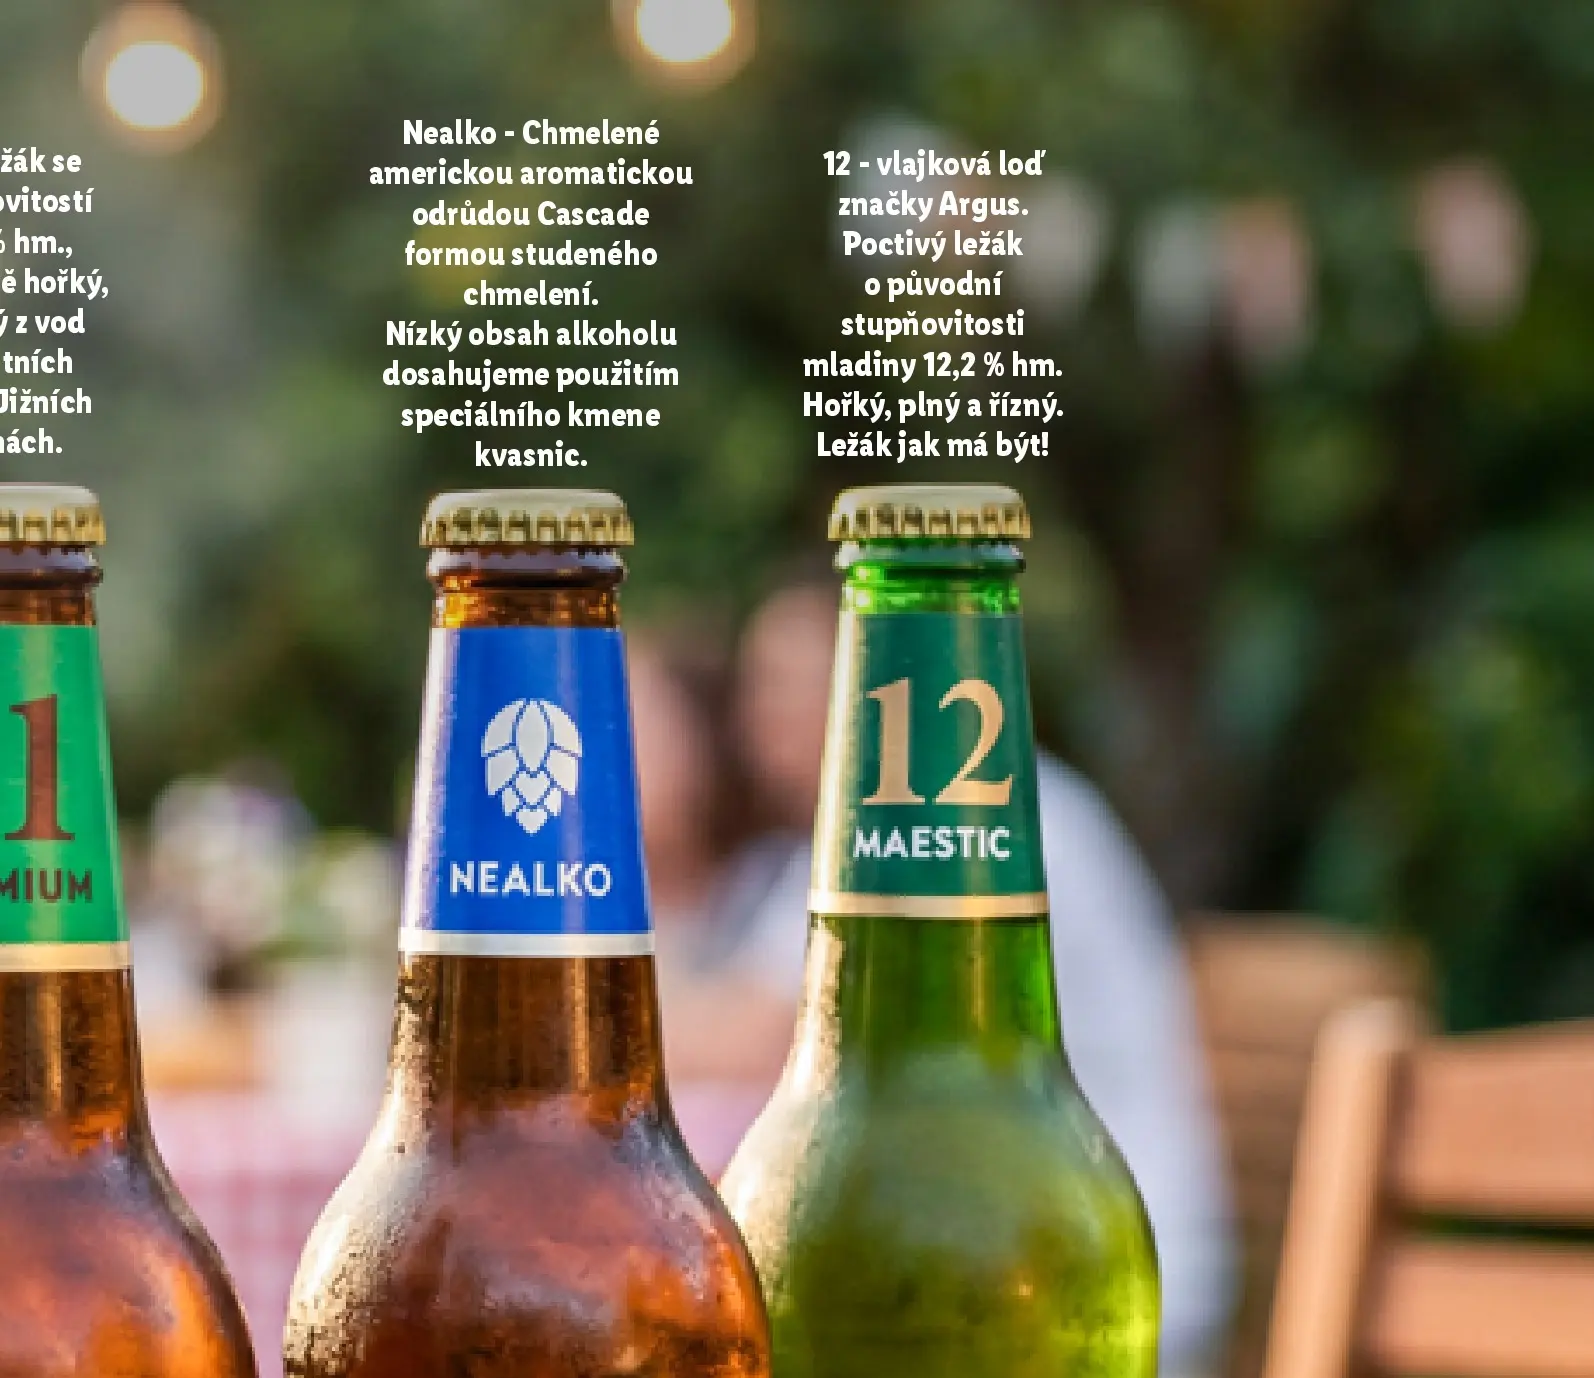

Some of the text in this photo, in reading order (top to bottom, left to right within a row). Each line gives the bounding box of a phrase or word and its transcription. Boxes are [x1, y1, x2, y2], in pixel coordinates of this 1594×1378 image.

[5, 694, 75, 840] 1
[862, 677, 1014, 806] 12
[450, 860, 612, 897] NEALKO
[852, 825, 1012, 860] MAESTIC
